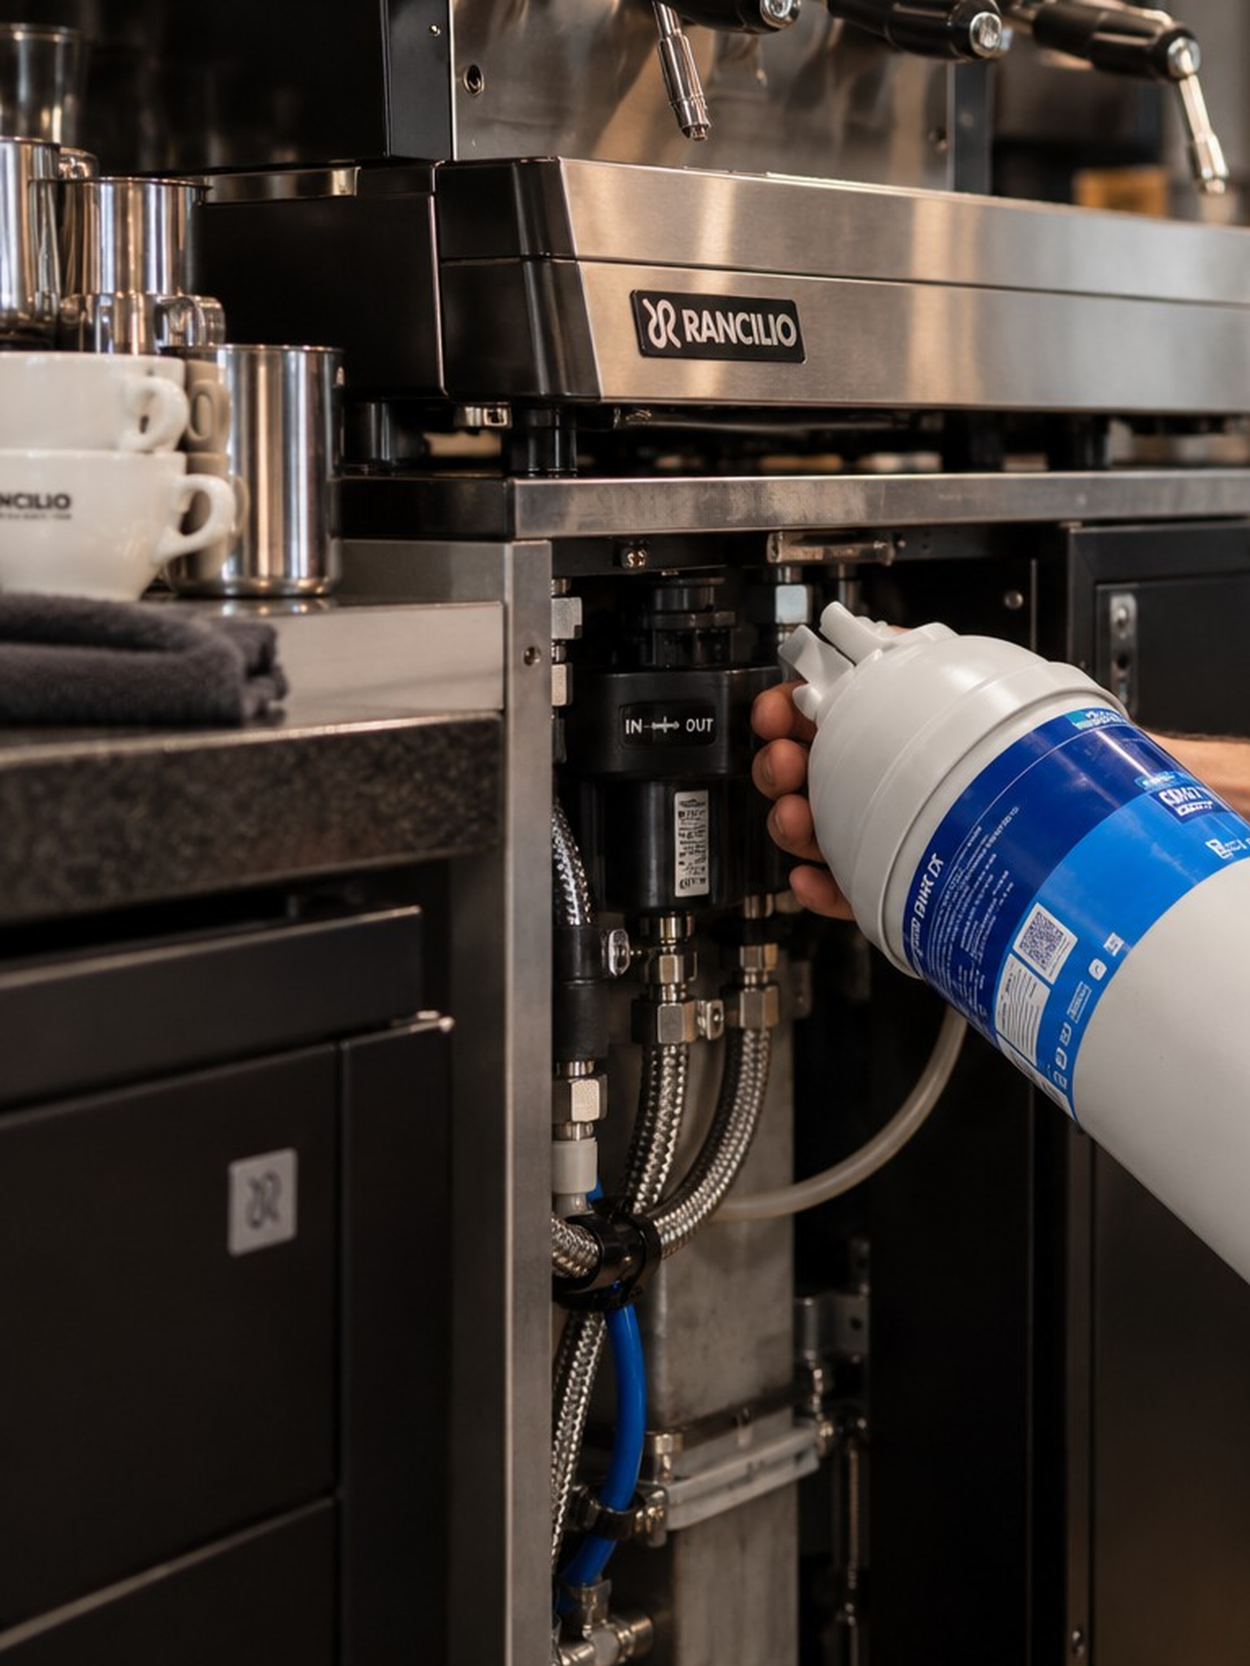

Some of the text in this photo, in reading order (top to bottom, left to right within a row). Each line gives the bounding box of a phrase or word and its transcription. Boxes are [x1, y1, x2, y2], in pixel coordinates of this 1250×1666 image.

[682, 309, 797, 347] RANCILIO
[625, 718, 714, 735] IN OUT
